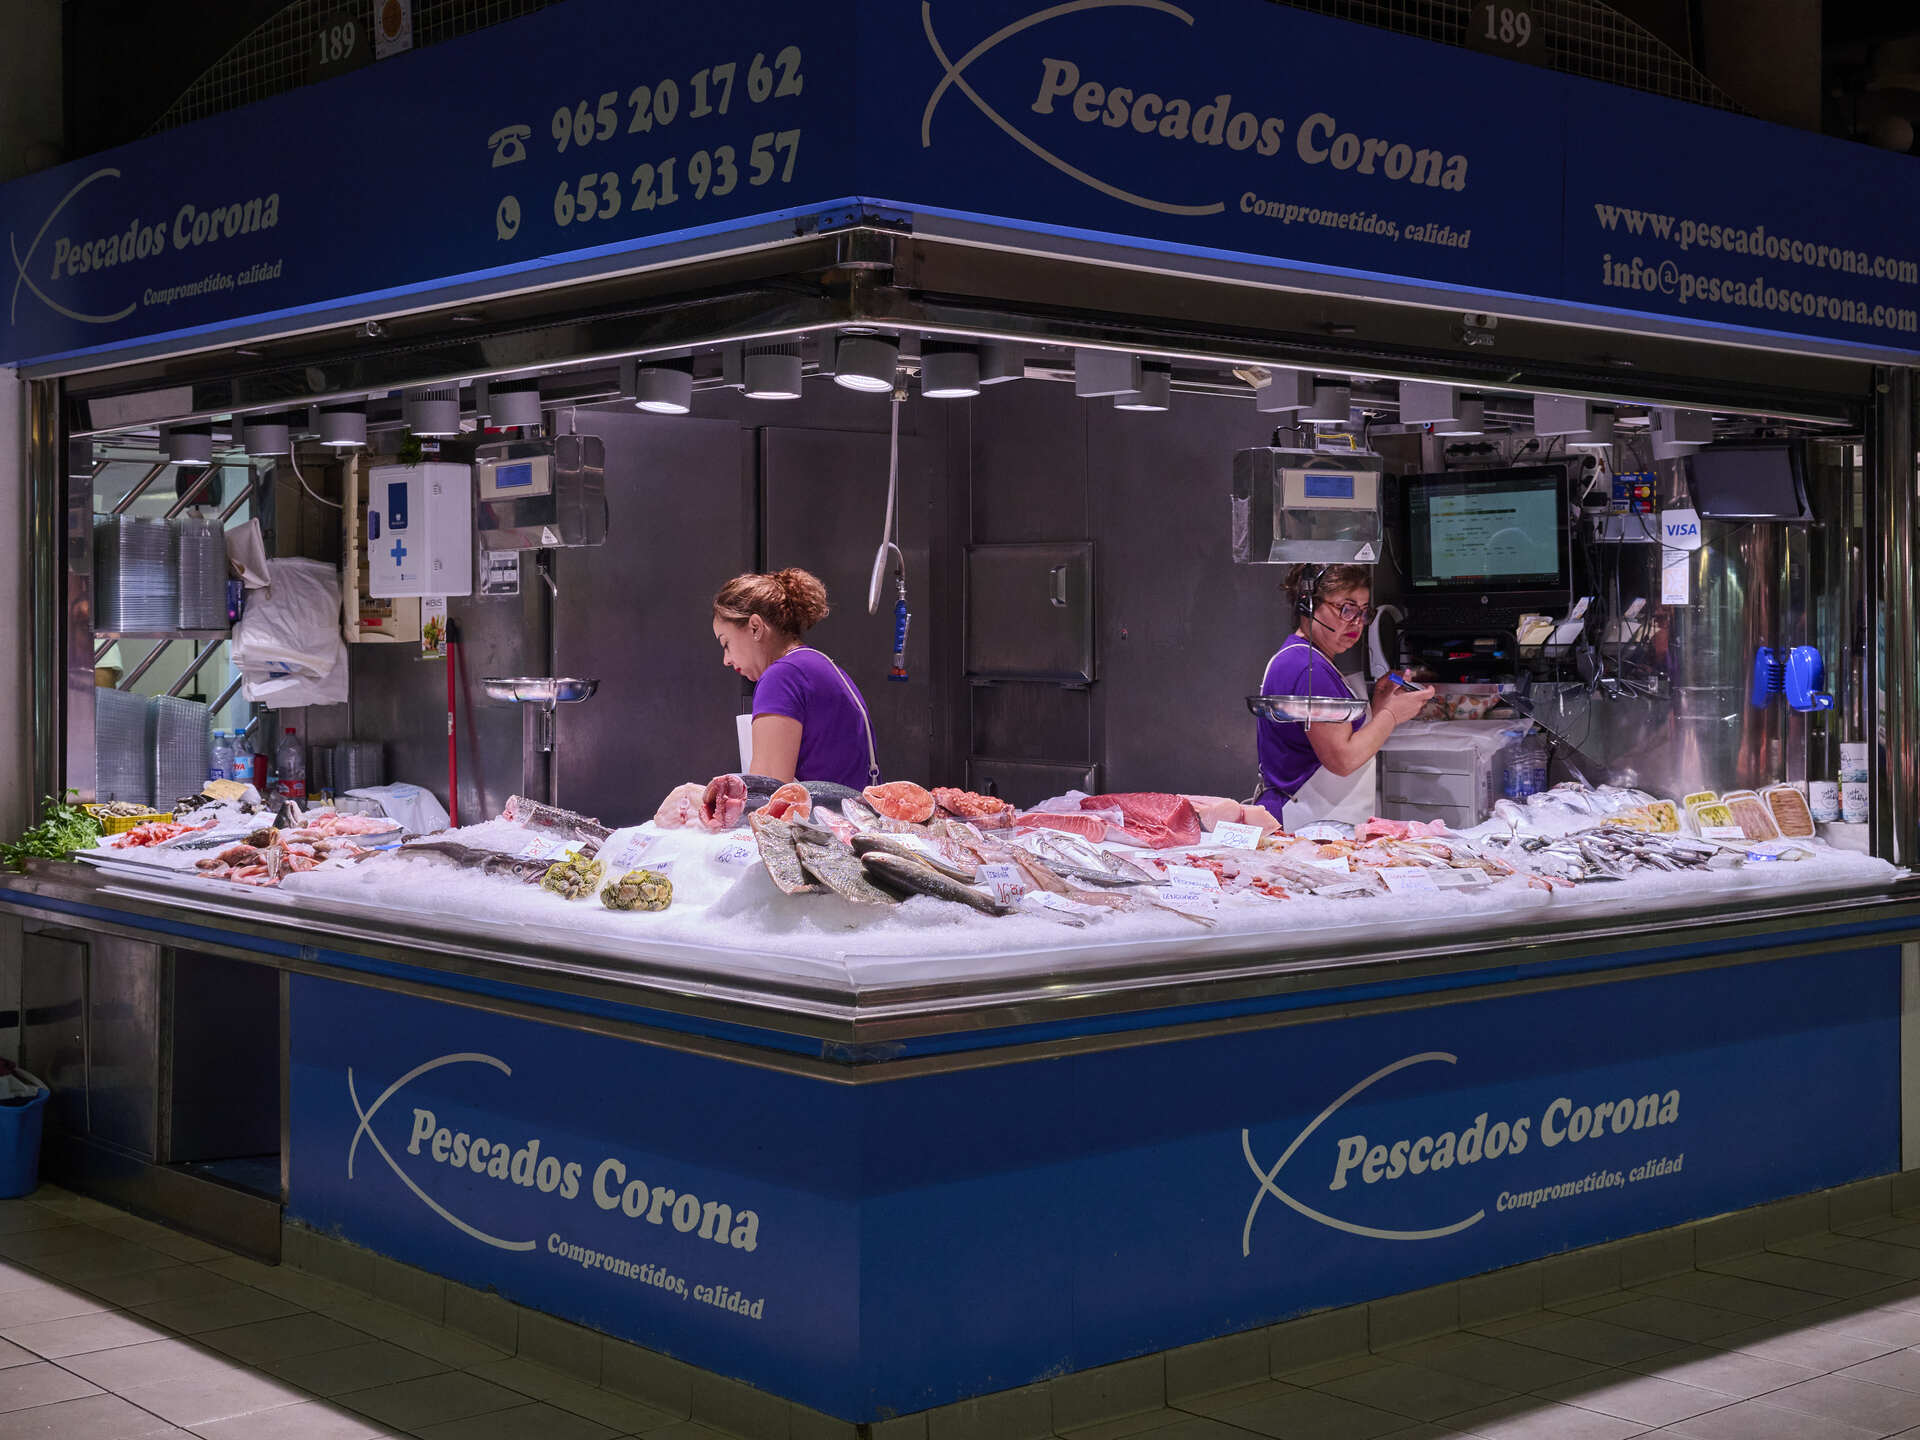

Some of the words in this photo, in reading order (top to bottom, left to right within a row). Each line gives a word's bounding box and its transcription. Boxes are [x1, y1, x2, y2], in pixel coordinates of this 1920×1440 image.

[318, 20, 356, 65] 189
[1484, 4, 1532, 48] 189
[551, 90, 619, 154] 965
[627, 78, 680, 134] 20
[689, 62, 737, 119] 17
[746, 45, 804, 104] 62
[1031, 57, 1285, 157] Pescados
[1296, 112, 1468, 192] Corona
[553, 171, 622, 227] 653
[631, 156, 679, 212] 21
[687, 144, 739, 201] 93
[749, 128, 801, 186] 57
[49, 202, 167, 282] Pescados
[172, 192, 280, 251] Corona
[236, 258, 283, 286] calidad
[1403, 222, 1472, 249] calidad
[1594, 203, 1918, 285] www.pescadoscorona.com
[1602, 253, 1918, 333] info@pescadoscorona.com
[1666, 523, 1697, 536] VISA
[406, 1108, 583, 1200] Pescados
[592, 1157, 760, 1253] Corona
[1328, 1112, 1531, 1191] Pescados
[1540, 1089, 1681, 1148] Corona
[1628, 1153, 1684, 1183] calidad
[547, 1232, 689, 1301] Comprometidos,
[693, 1284, 765, 1320] calidad
